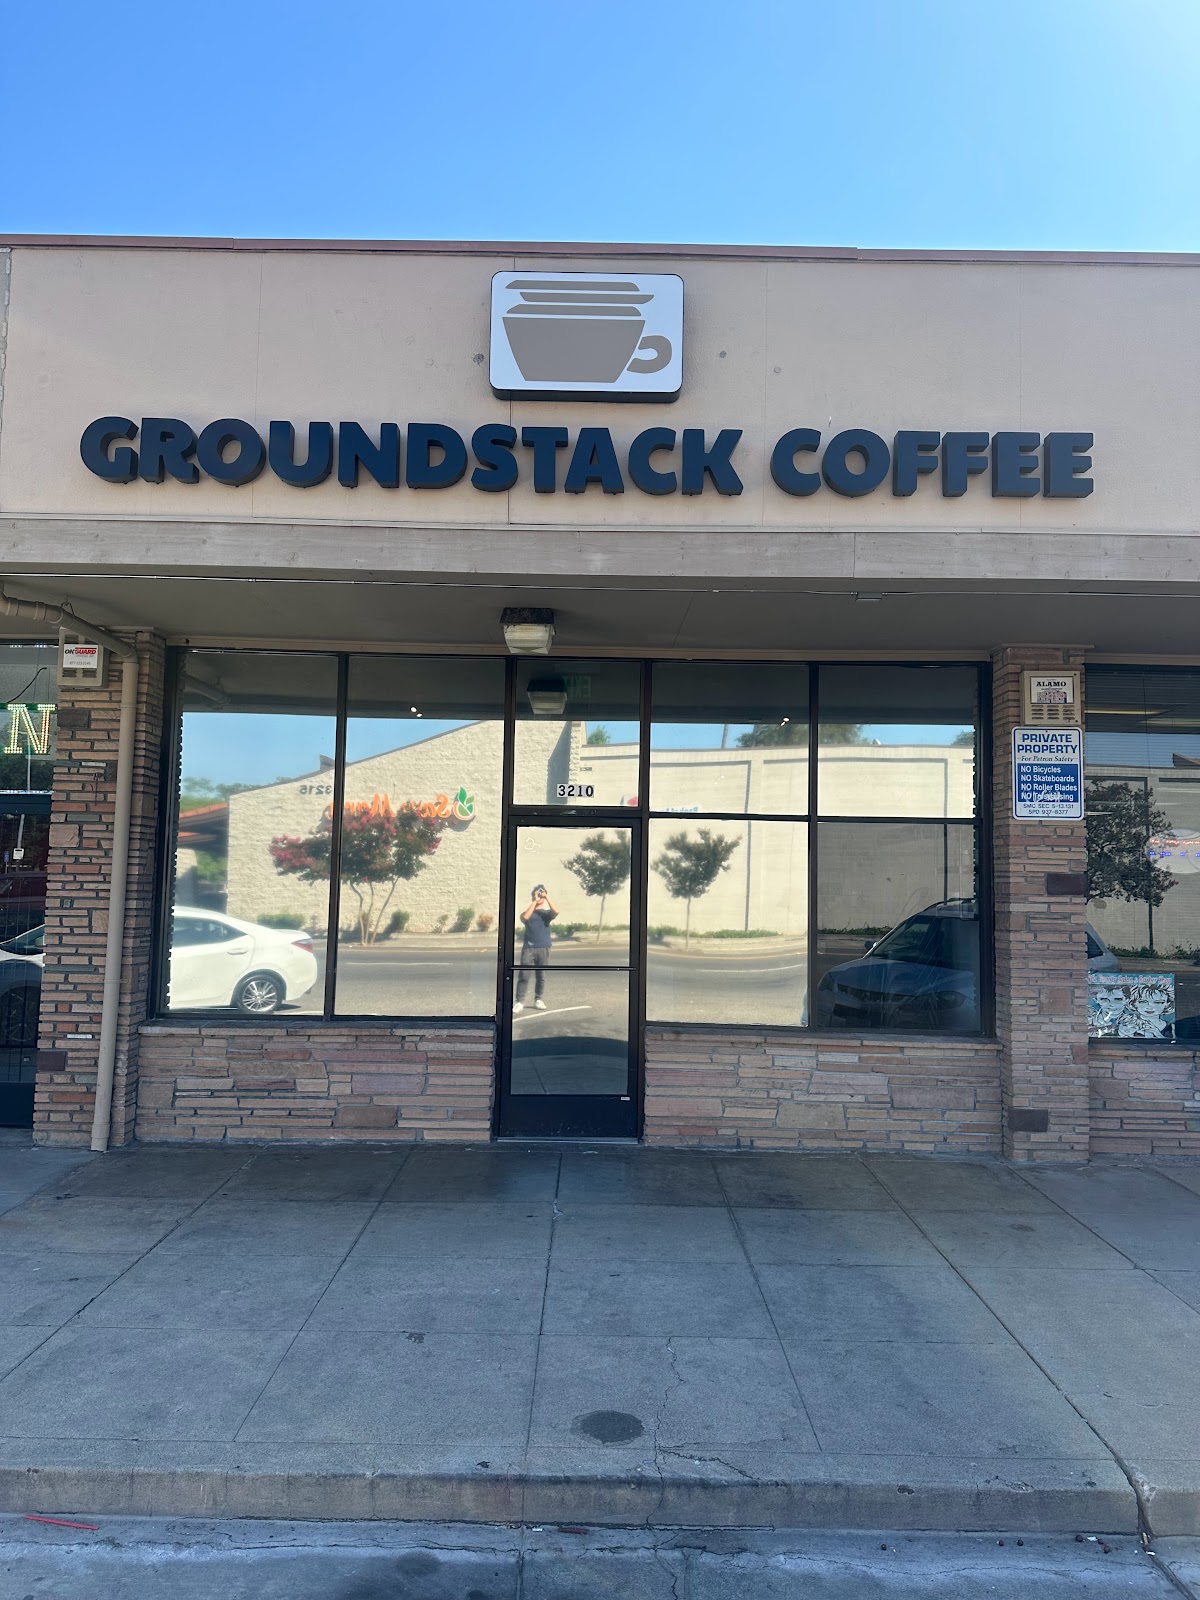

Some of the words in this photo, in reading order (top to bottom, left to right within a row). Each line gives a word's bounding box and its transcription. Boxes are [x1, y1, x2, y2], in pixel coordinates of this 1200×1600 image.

[80, 416, 743, 496] GROUNDSTACK
[770, 428, 1094, 498] COFFEE
[1022, 733, 1072, 743] PRIVATE
[1017, 744, 1078, 754] PROPERTY
[1054, 755, 1074, 763] Safety
[1020, 765, 1031, 773] NO
[1033, 765, 1061, 774] Bicycles
[1020, 774, 1031, 782] NO
[1033, 774, 1075, 782] Skateboards
[558, 785, 594, 797] 3210
[1021, 783, 1032, 791] NO
[1033, 783, 1053, 791] Roller
[1054, 783, 1077, 791] Blades
[1021, 792, 1032, 800] NO
